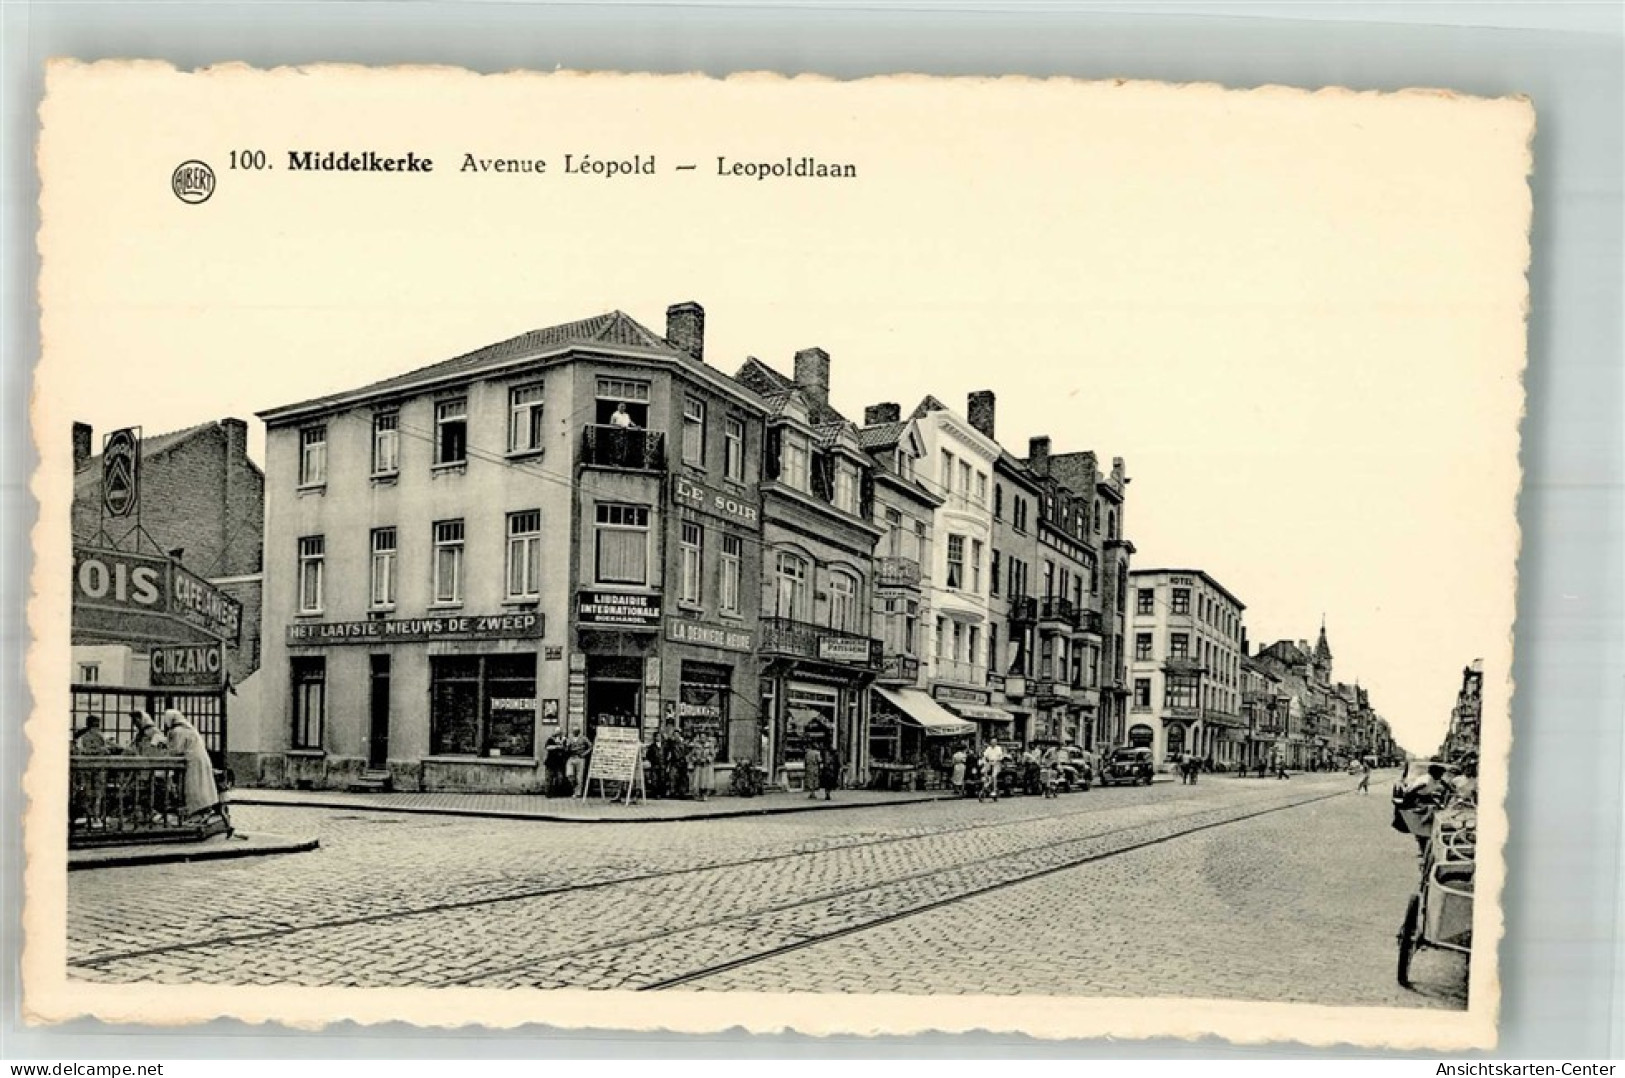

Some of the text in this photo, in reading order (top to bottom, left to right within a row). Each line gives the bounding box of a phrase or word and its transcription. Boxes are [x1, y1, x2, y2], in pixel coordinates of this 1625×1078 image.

[229, 149, 273, 170] 100.
[287, 150, 434, 173] Middelkerke
[459, 153, 546, 174] Avenue
[564, 153, 655, 178] Léopold
[716, 156, 857, 181] Leopoldlaan
[677, 479, 757, 521] LE SOIR
[72, 557, 159, 604] OIS
[1169, 576, 1194, 586] HOTEL
[581, 604, 660, 617] INTERNATIONALE
[594, 594, 648, 607] LIBRAIRIE
[291, 615, 536, 637] HET LAATSTE NIEUWS DE ZWEEP
[673, 622, 685, 639] LA
[152, 648, 220, 674] CINZANO
